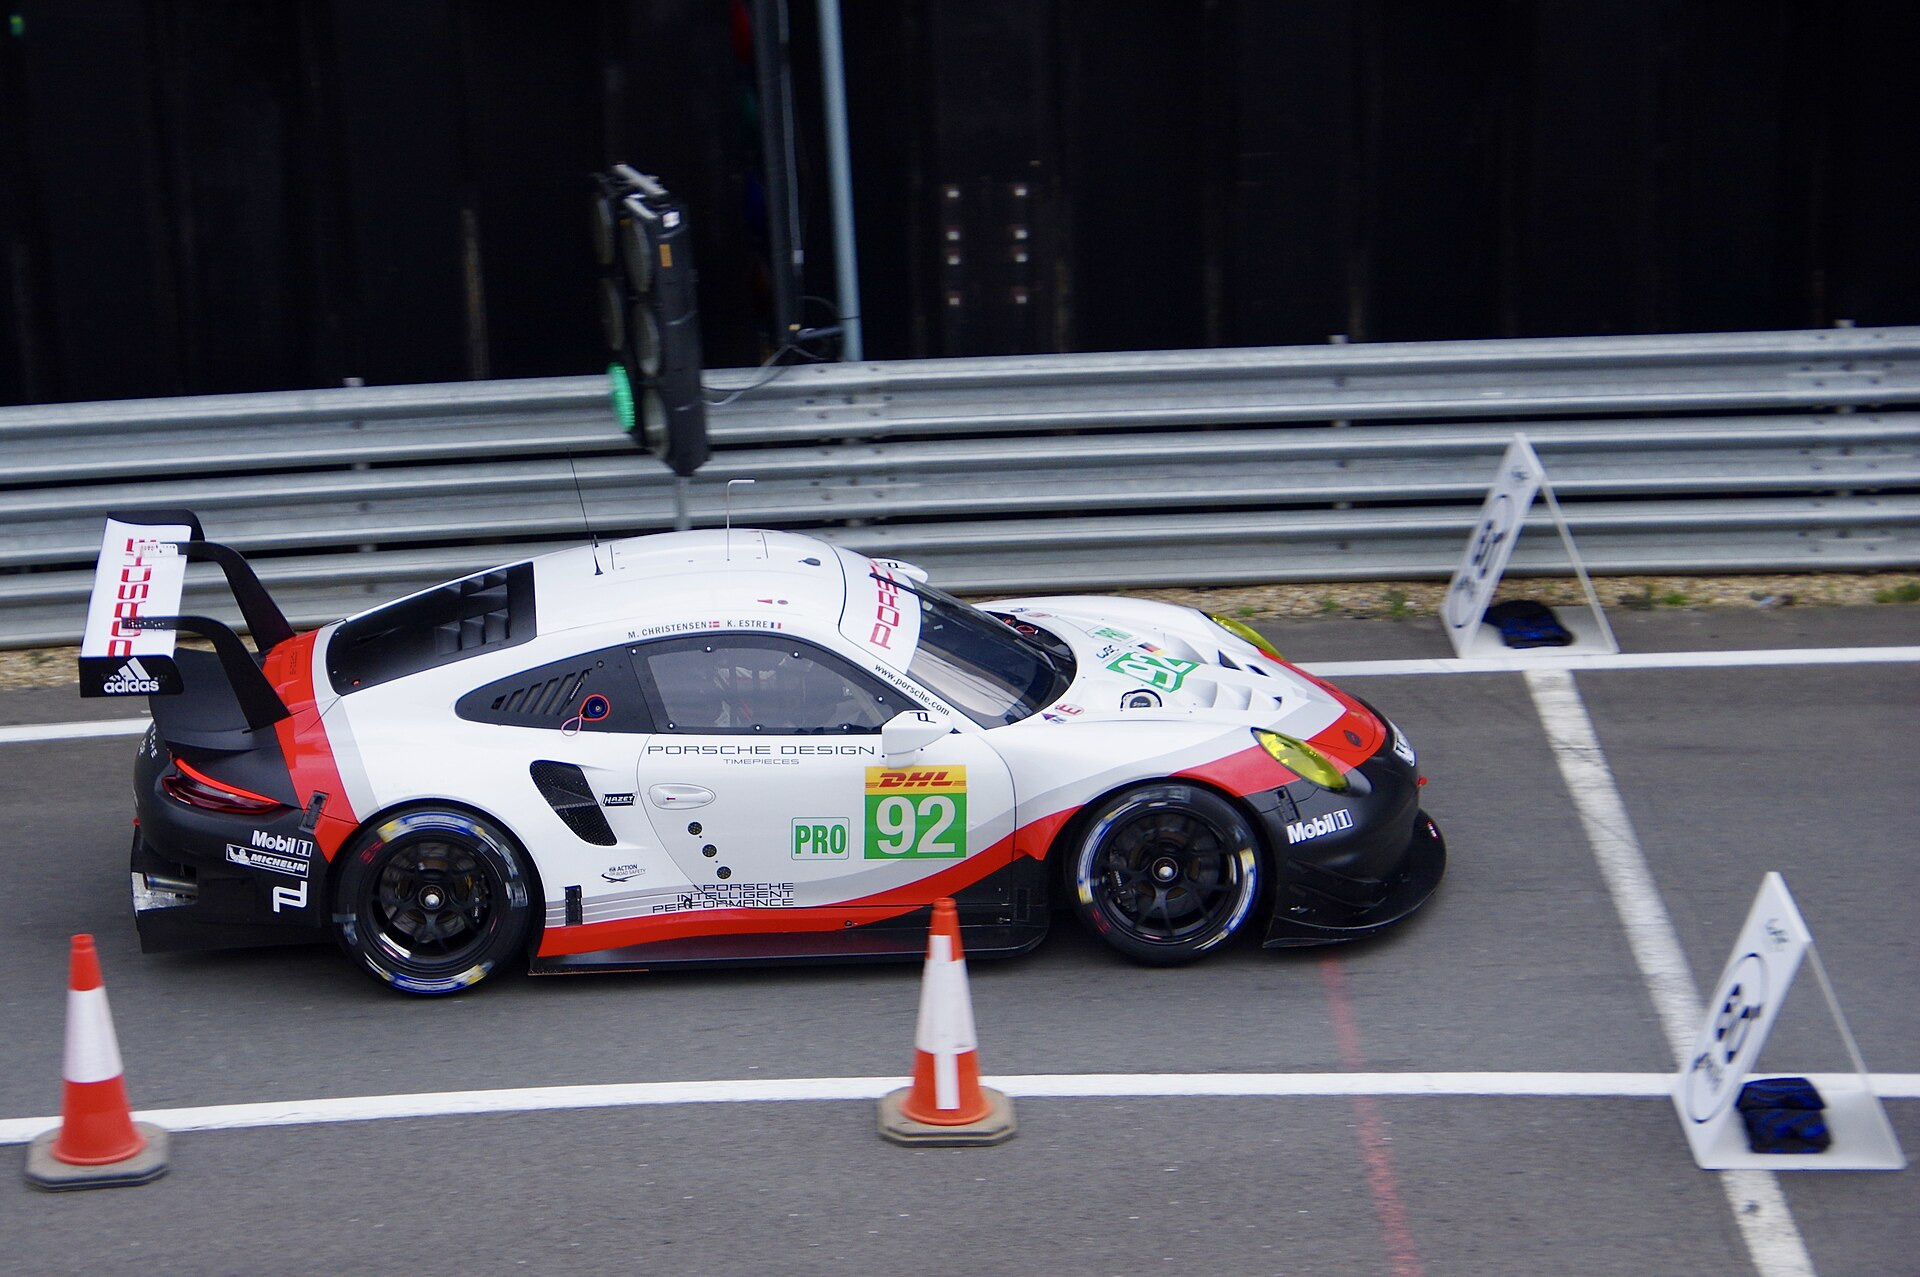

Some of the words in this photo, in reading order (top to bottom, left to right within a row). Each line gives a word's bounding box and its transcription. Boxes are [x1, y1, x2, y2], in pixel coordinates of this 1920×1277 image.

[642, 621, 707, 636] CHRISTENSEN
[739, 620, 768, 628] ESTRE
[104, 677, 159, 694] adidas
[875, 664, 950, 716] www.porsche.com
[648, 745, 771, 755] PORSCHE
[781, 745, 875, 755] DESIGN
[879, 771, 954, 788] DHL
[605, 796, 634, 804] HAZET
[876, 795, 956, 855] 92
[1286, 813, 1337, 844] Mobil
[251, 830, 296, 854] Mobil
[795, 824, 847, 854] PRO
[251, 854, 306, 872] MICHELIN
[617, 864, 638, 872] ACTION
[703, 882, 794, 892] PORSCHE
[677, 890, 794, 903] INTELLIGENT
[652, 898, 794, 914] PERFORMANCE
